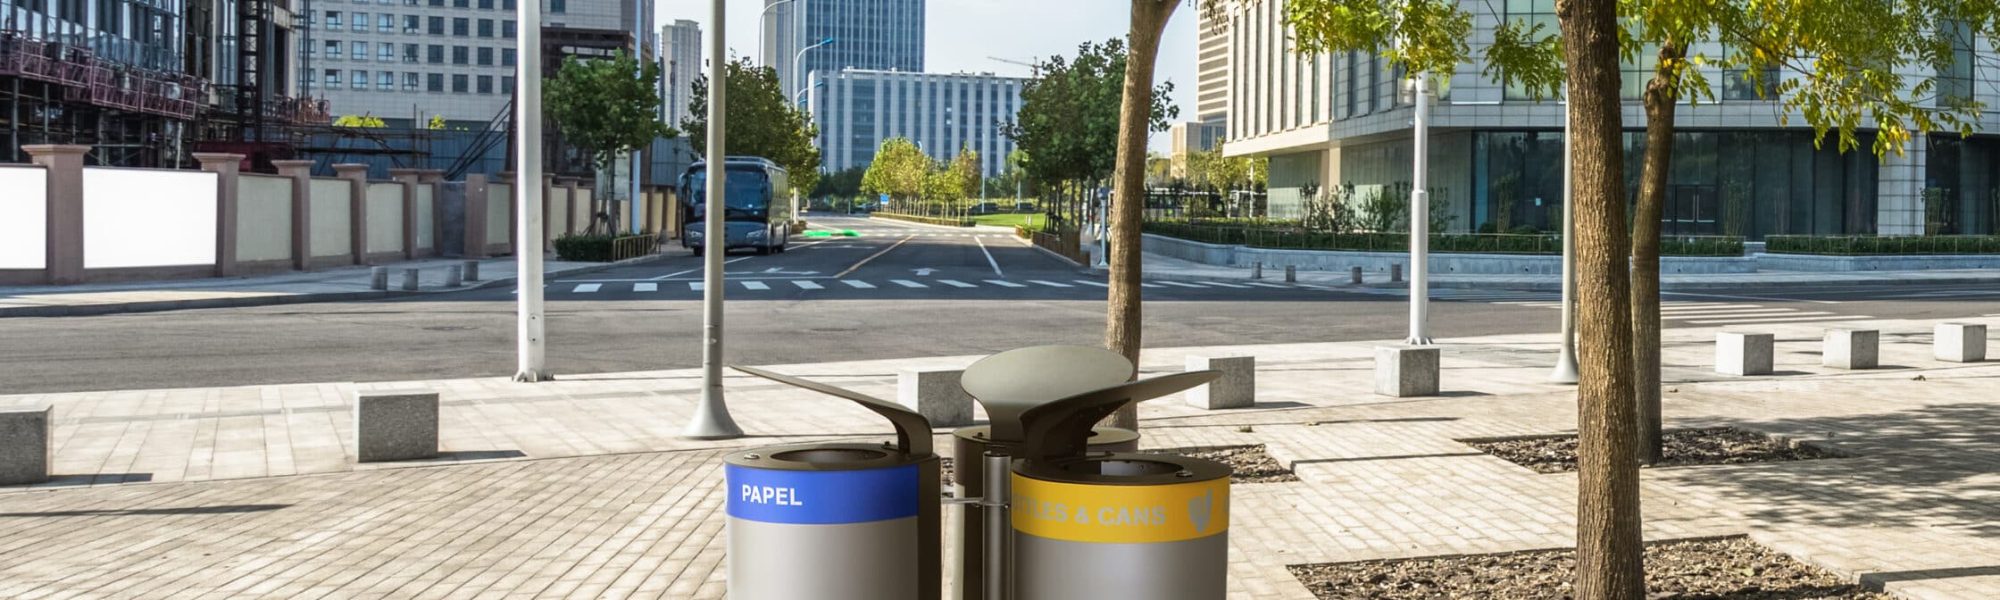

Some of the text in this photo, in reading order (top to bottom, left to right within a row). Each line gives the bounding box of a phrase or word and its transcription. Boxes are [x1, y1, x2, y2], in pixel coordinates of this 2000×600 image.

[742, 484, 803, 506] PAPEL
[1074, 504, 1090, 524] &
[1096, 505, 1168, 526] CANS
